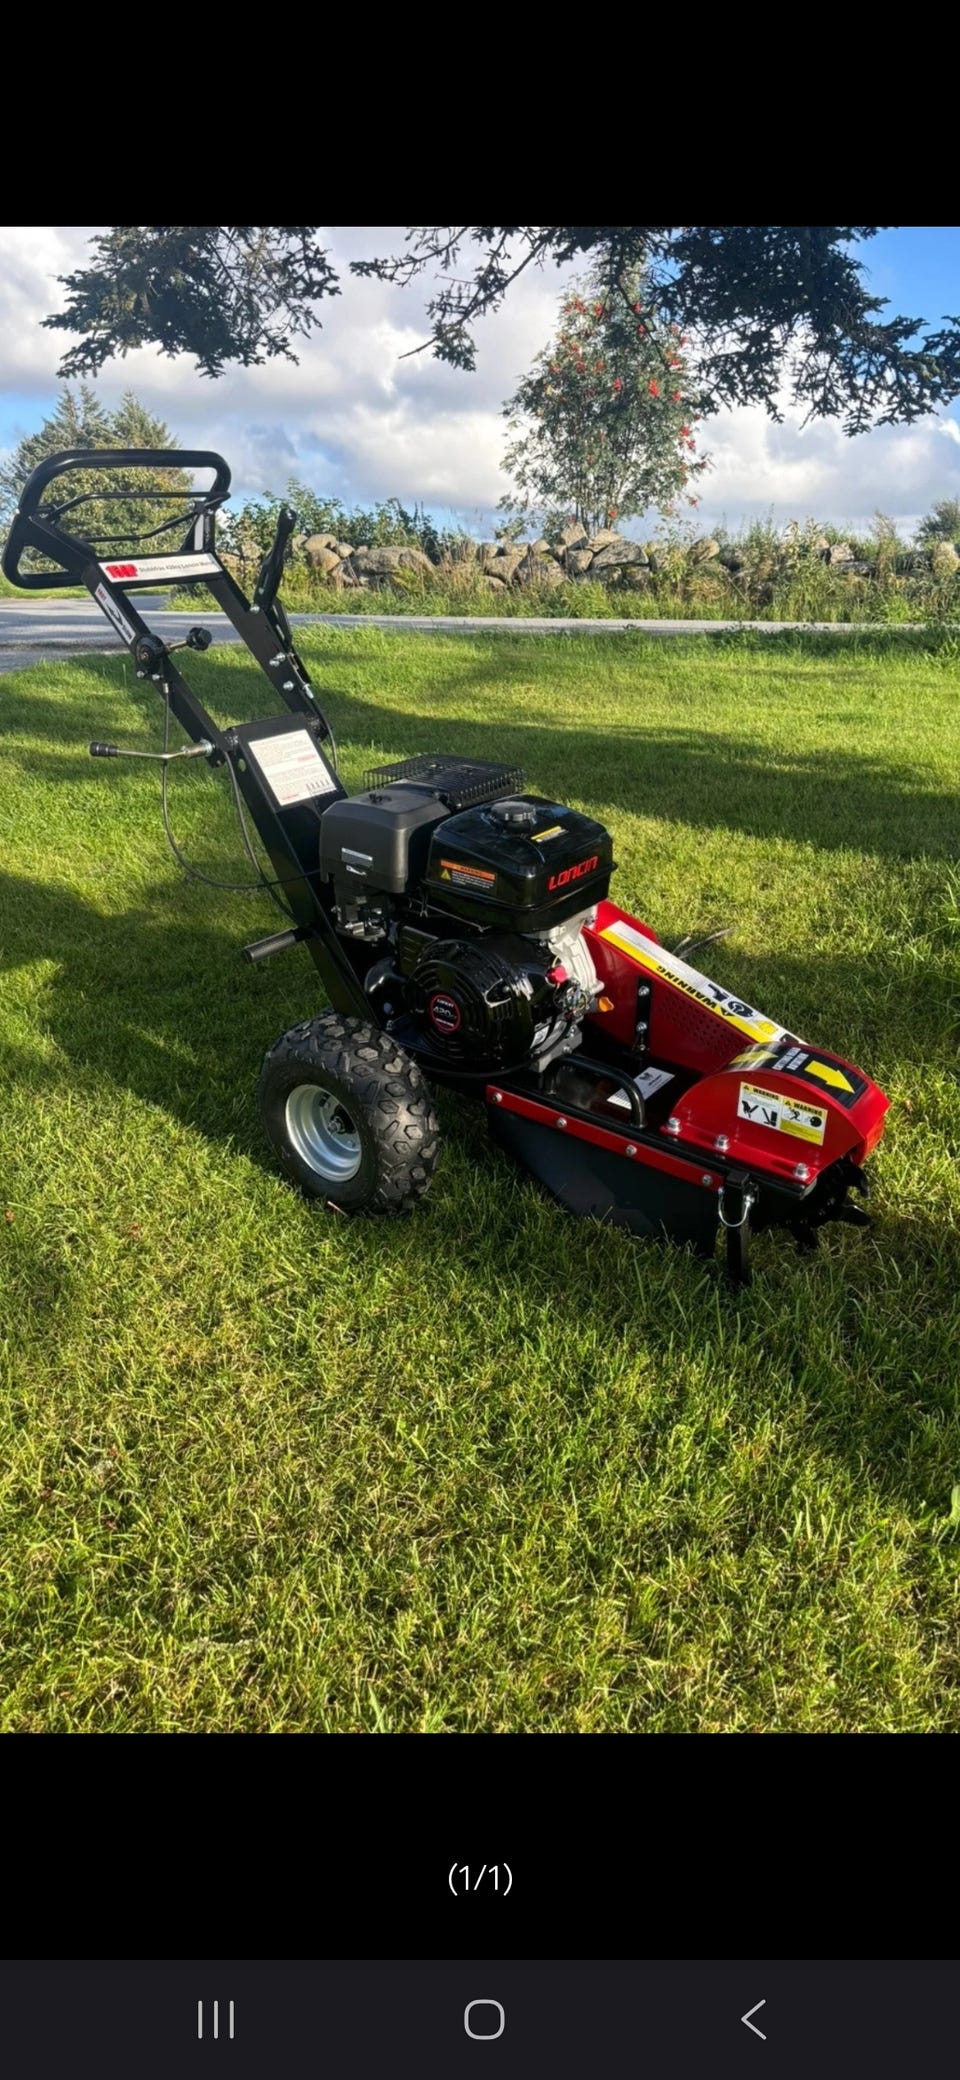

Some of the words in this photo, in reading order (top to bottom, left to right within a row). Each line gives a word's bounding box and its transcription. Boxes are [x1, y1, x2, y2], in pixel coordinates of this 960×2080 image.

[547, 856, 598, 891] LONCIN
[656, 965, 718, 1011] WARNING
[753, 1085, 780, 1101] WARNING
[794, 1102, 824, 1117] WARNING
